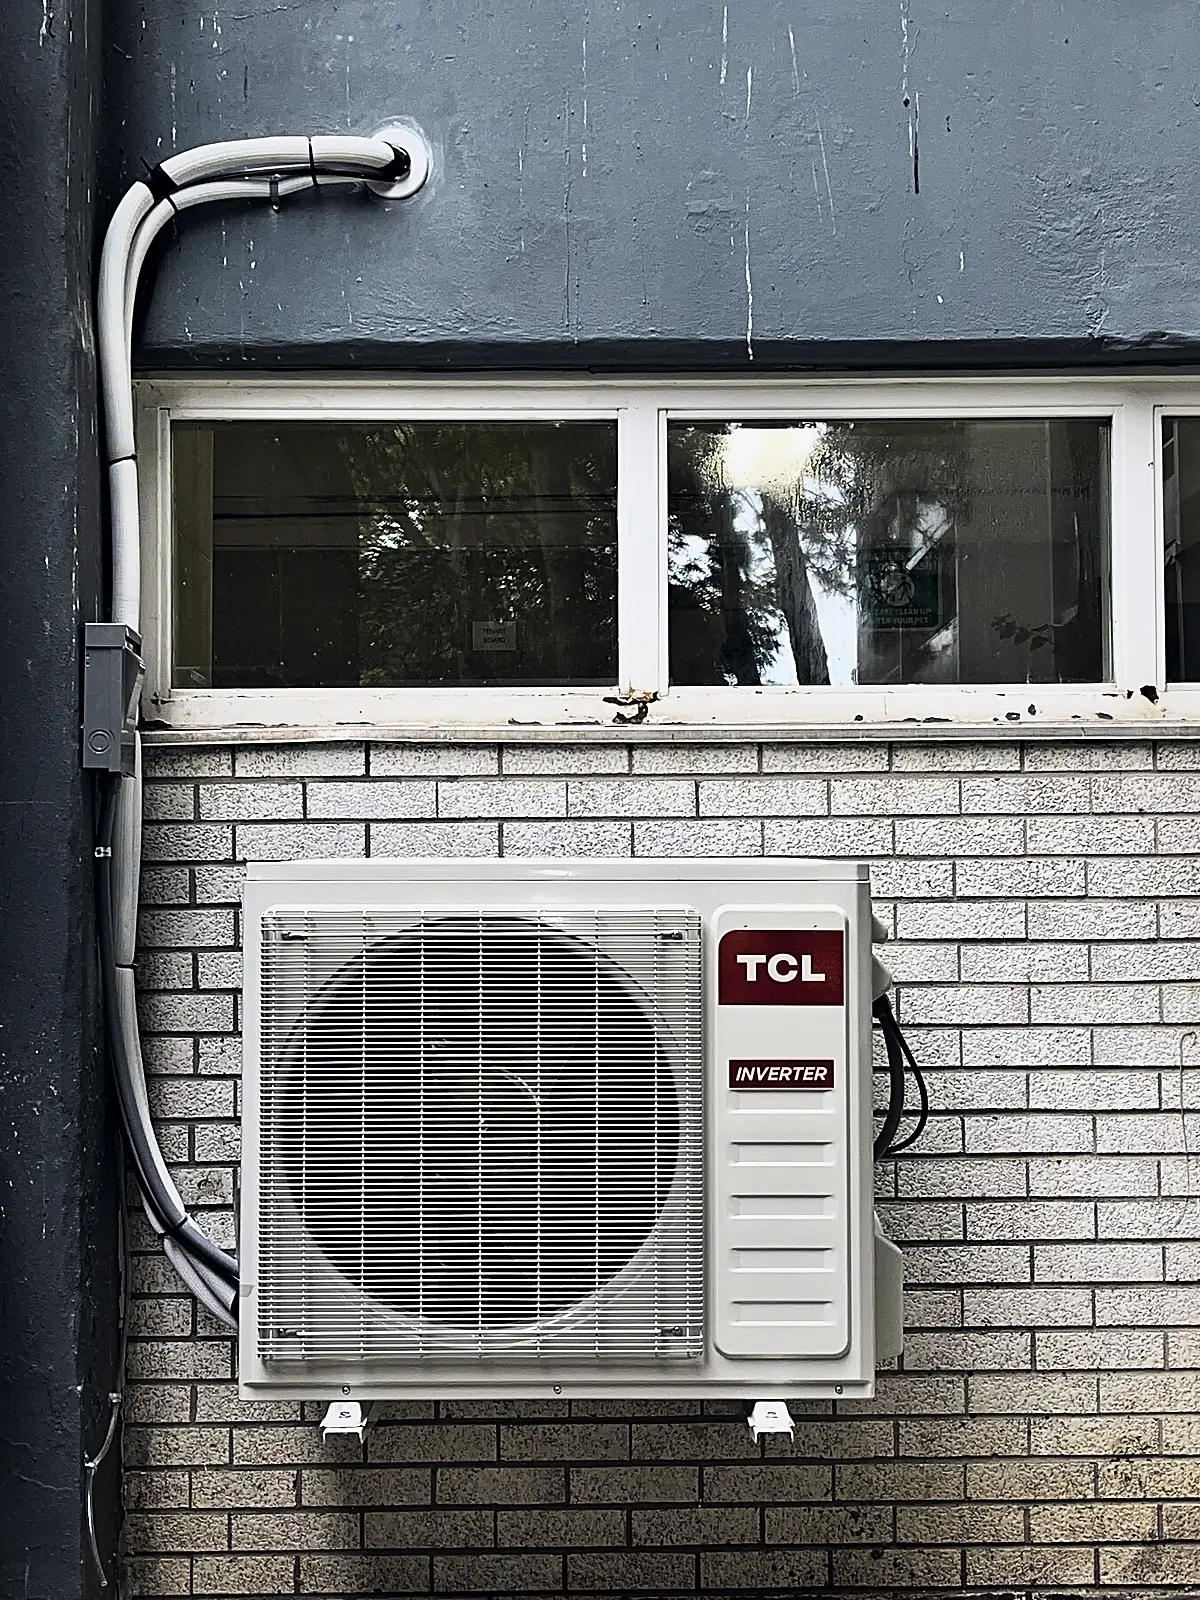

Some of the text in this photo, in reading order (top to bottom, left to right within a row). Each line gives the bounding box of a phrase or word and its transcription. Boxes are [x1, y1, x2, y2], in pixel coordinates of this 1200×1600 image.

[893, 616, 914, 624] YOUR
[914, 616, 928, 624] PET
[736, 953, 826, 982] TCL
[735, 1066, 828, 1082] INVERTER
